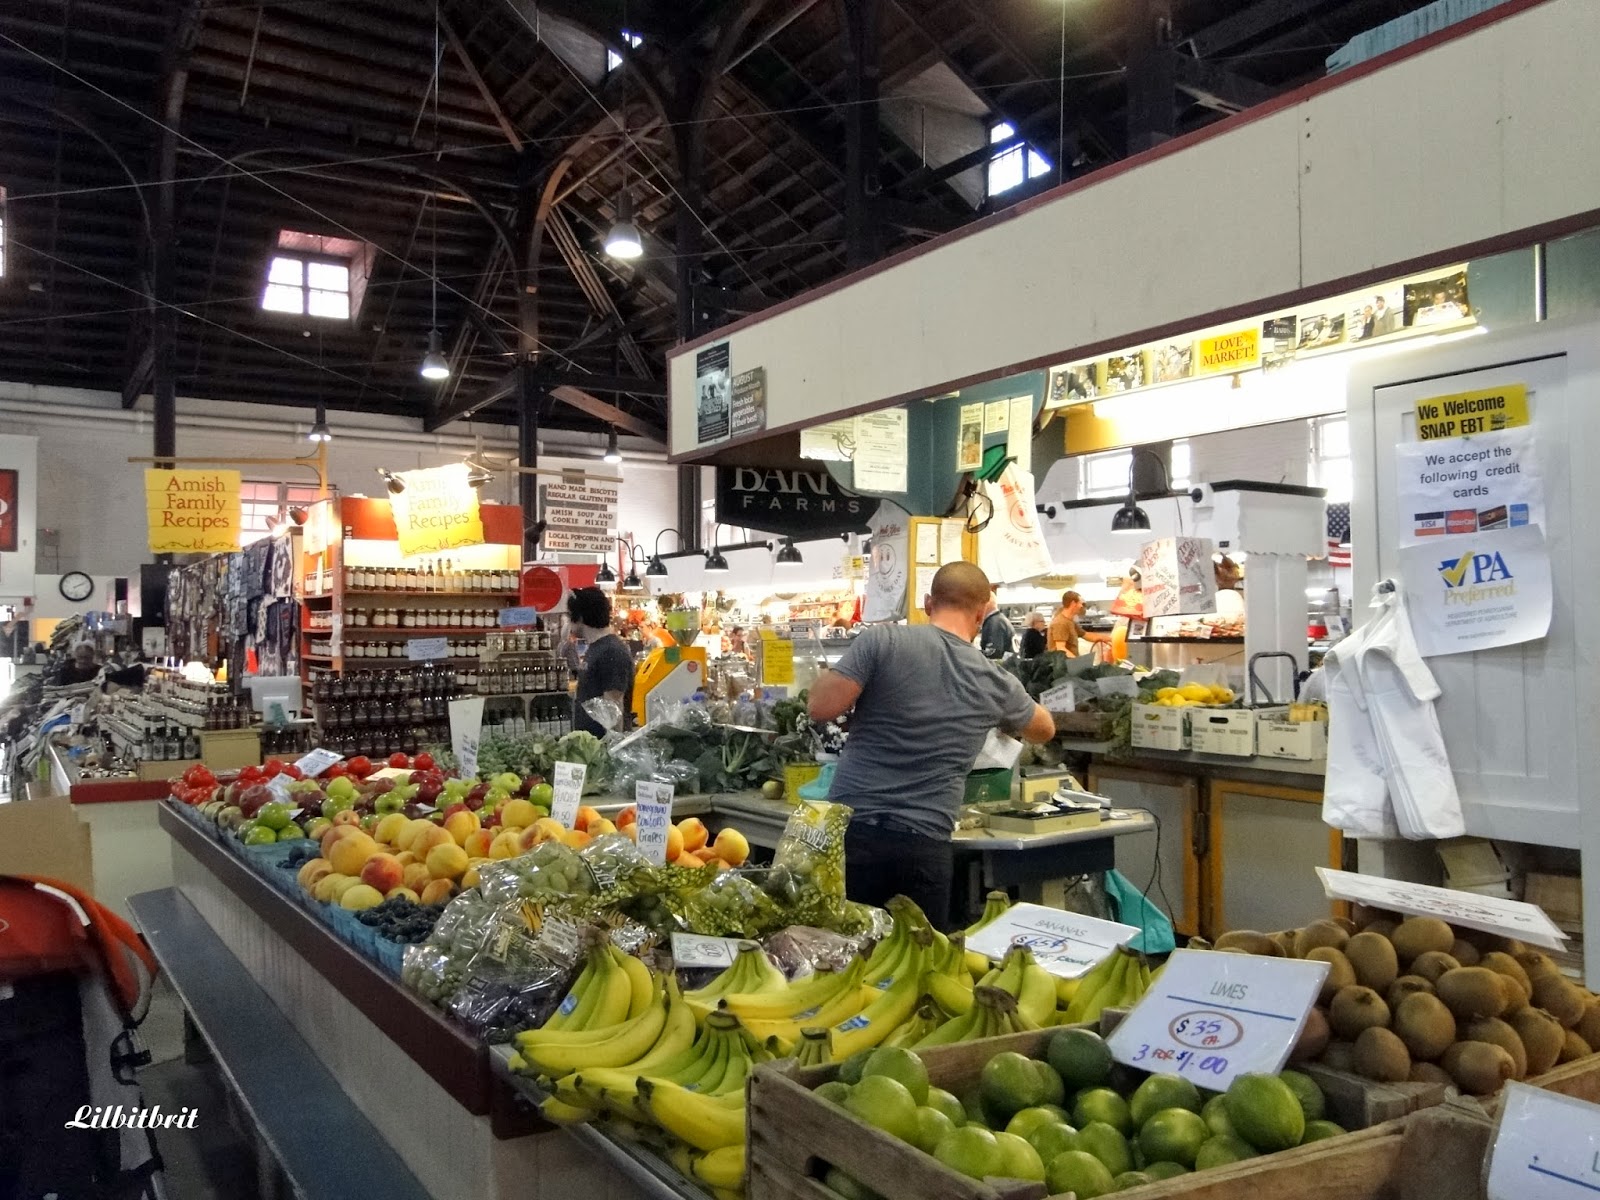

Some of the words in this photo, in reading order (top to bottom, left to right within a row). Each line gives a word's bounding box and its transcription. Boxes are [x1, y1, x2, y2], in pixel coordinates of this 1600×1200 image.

[1214, 336, 1243, 351] LOVE
[1203, 344, 1254, 366] MARKET!
[744, 395, 754, 403] local
[1418, 405, 1438, 420] We
[1443, 396, 1505, 416] Welcome
[1420, 421, 1455, 440] SNAP
[1461, 417, 1485, 434] EBT
[1425, 455, 1445, 466] We
[1449, 449, 1490, 463] accept
[1494, 446, 1512, 458] the
[1420, 469, 1478, 484] following
[1485, 463, 1520, 477] credit
[165, 476, 225, 492] Amish
[548, 483, 567, 491] HAND
[568, 485, 586, 493] MADE
[590, 487, 617, 496] BISCOTTI
[1453, 485, 1489, 498] cards
[166, 493, 227, 514] Family
[547, 491, 576, 500] REGULAR
[162, 511, 229, 532] Recipes
[409, 511, 470, 530] Recipes
[552, 516, 579, 524] COOKIE
[585, 519, 608, 527] MIXES
[1421, 520, 1436, 528] VISA
[548, 532, 569, 540] LOCAL
[570, 534, 599, 542] POPCORN
[549, 540, 569, 548] FRESH
[590, 543, 612, 551] CAKES
[1472, 551, 1514, 584] PA
[1443, 580, 1519, 606] Preferred
[1035, 920, 1088, 937] BANANAS
[1210, 981, 1248, 1000] LIMES
[1132, 1044, 1150, 1061] 3
[1151, 1048, 1175, 1060] FOR
